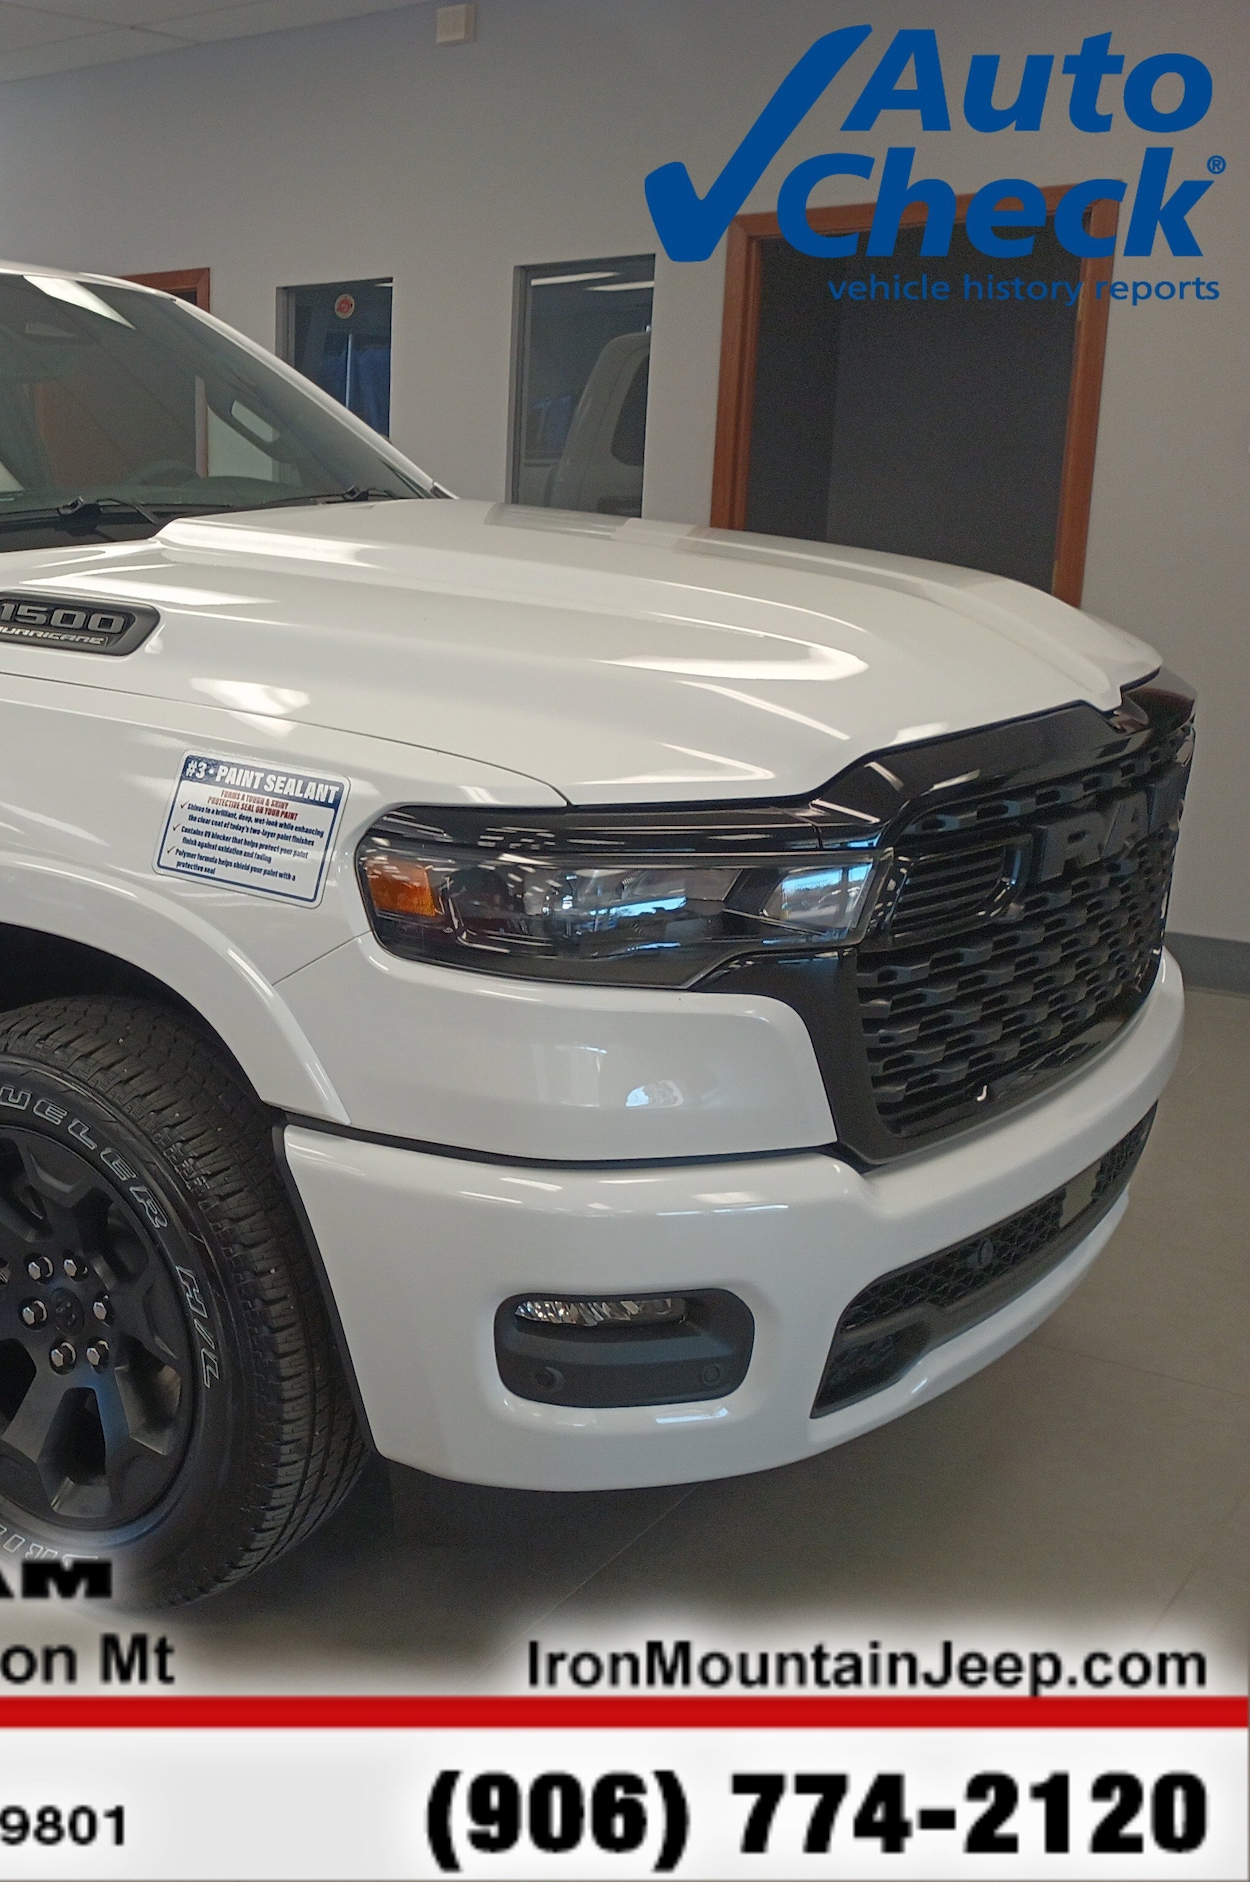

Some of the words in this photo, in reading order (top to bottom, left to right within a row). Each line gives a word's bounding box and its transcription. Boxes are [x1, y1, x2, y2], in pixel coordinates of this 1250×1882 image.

[1, 602, 126, 633] 1500
[215, 765, 265, 790] PAINT
[263, 774, 339, 804] SEALANT
[208, 796, 240, 809] PROTECTIVE
[241, 803, 255, 812] SEAL
[264, 807, 280, 817] YOUR
[280, 810, 298, 821] PAINT
[188, 814, 197, 822] the
[197, 816, 211, 825] clear
[211, 819, 224, 827] coat
[229, 823, 249, 834] today's
[249, 827, 276, 840] two-layer
[276, 833, 292, 843] paint
[292, 836, 315, 846] finishes
[211, 832, 231, 842] blocker
[232, 837, 243, 845] that
[243, 839, 258, 849] helps
[259, 842, 280, 854] protect
[294, 825, 325, 838] enhancing
[182, 837, 197, 846] finish
[197, 840, 218, 852] against
[244, 850, 254, 858] and
[175, 849, 197, 860] Polymer
[197, 853, 218, 864] formula
[217, 858, 233, 868] helps
[233, 861, 250, 871] shield
[250, 867, 263, 875] your
[263, 868, 278, 879] paint
[278, 871, 291, 880] with
[176, 860, 204, 872] protective
[204, 866, 216, 874] seal
[175, 1264, 220, 1389] H/L
